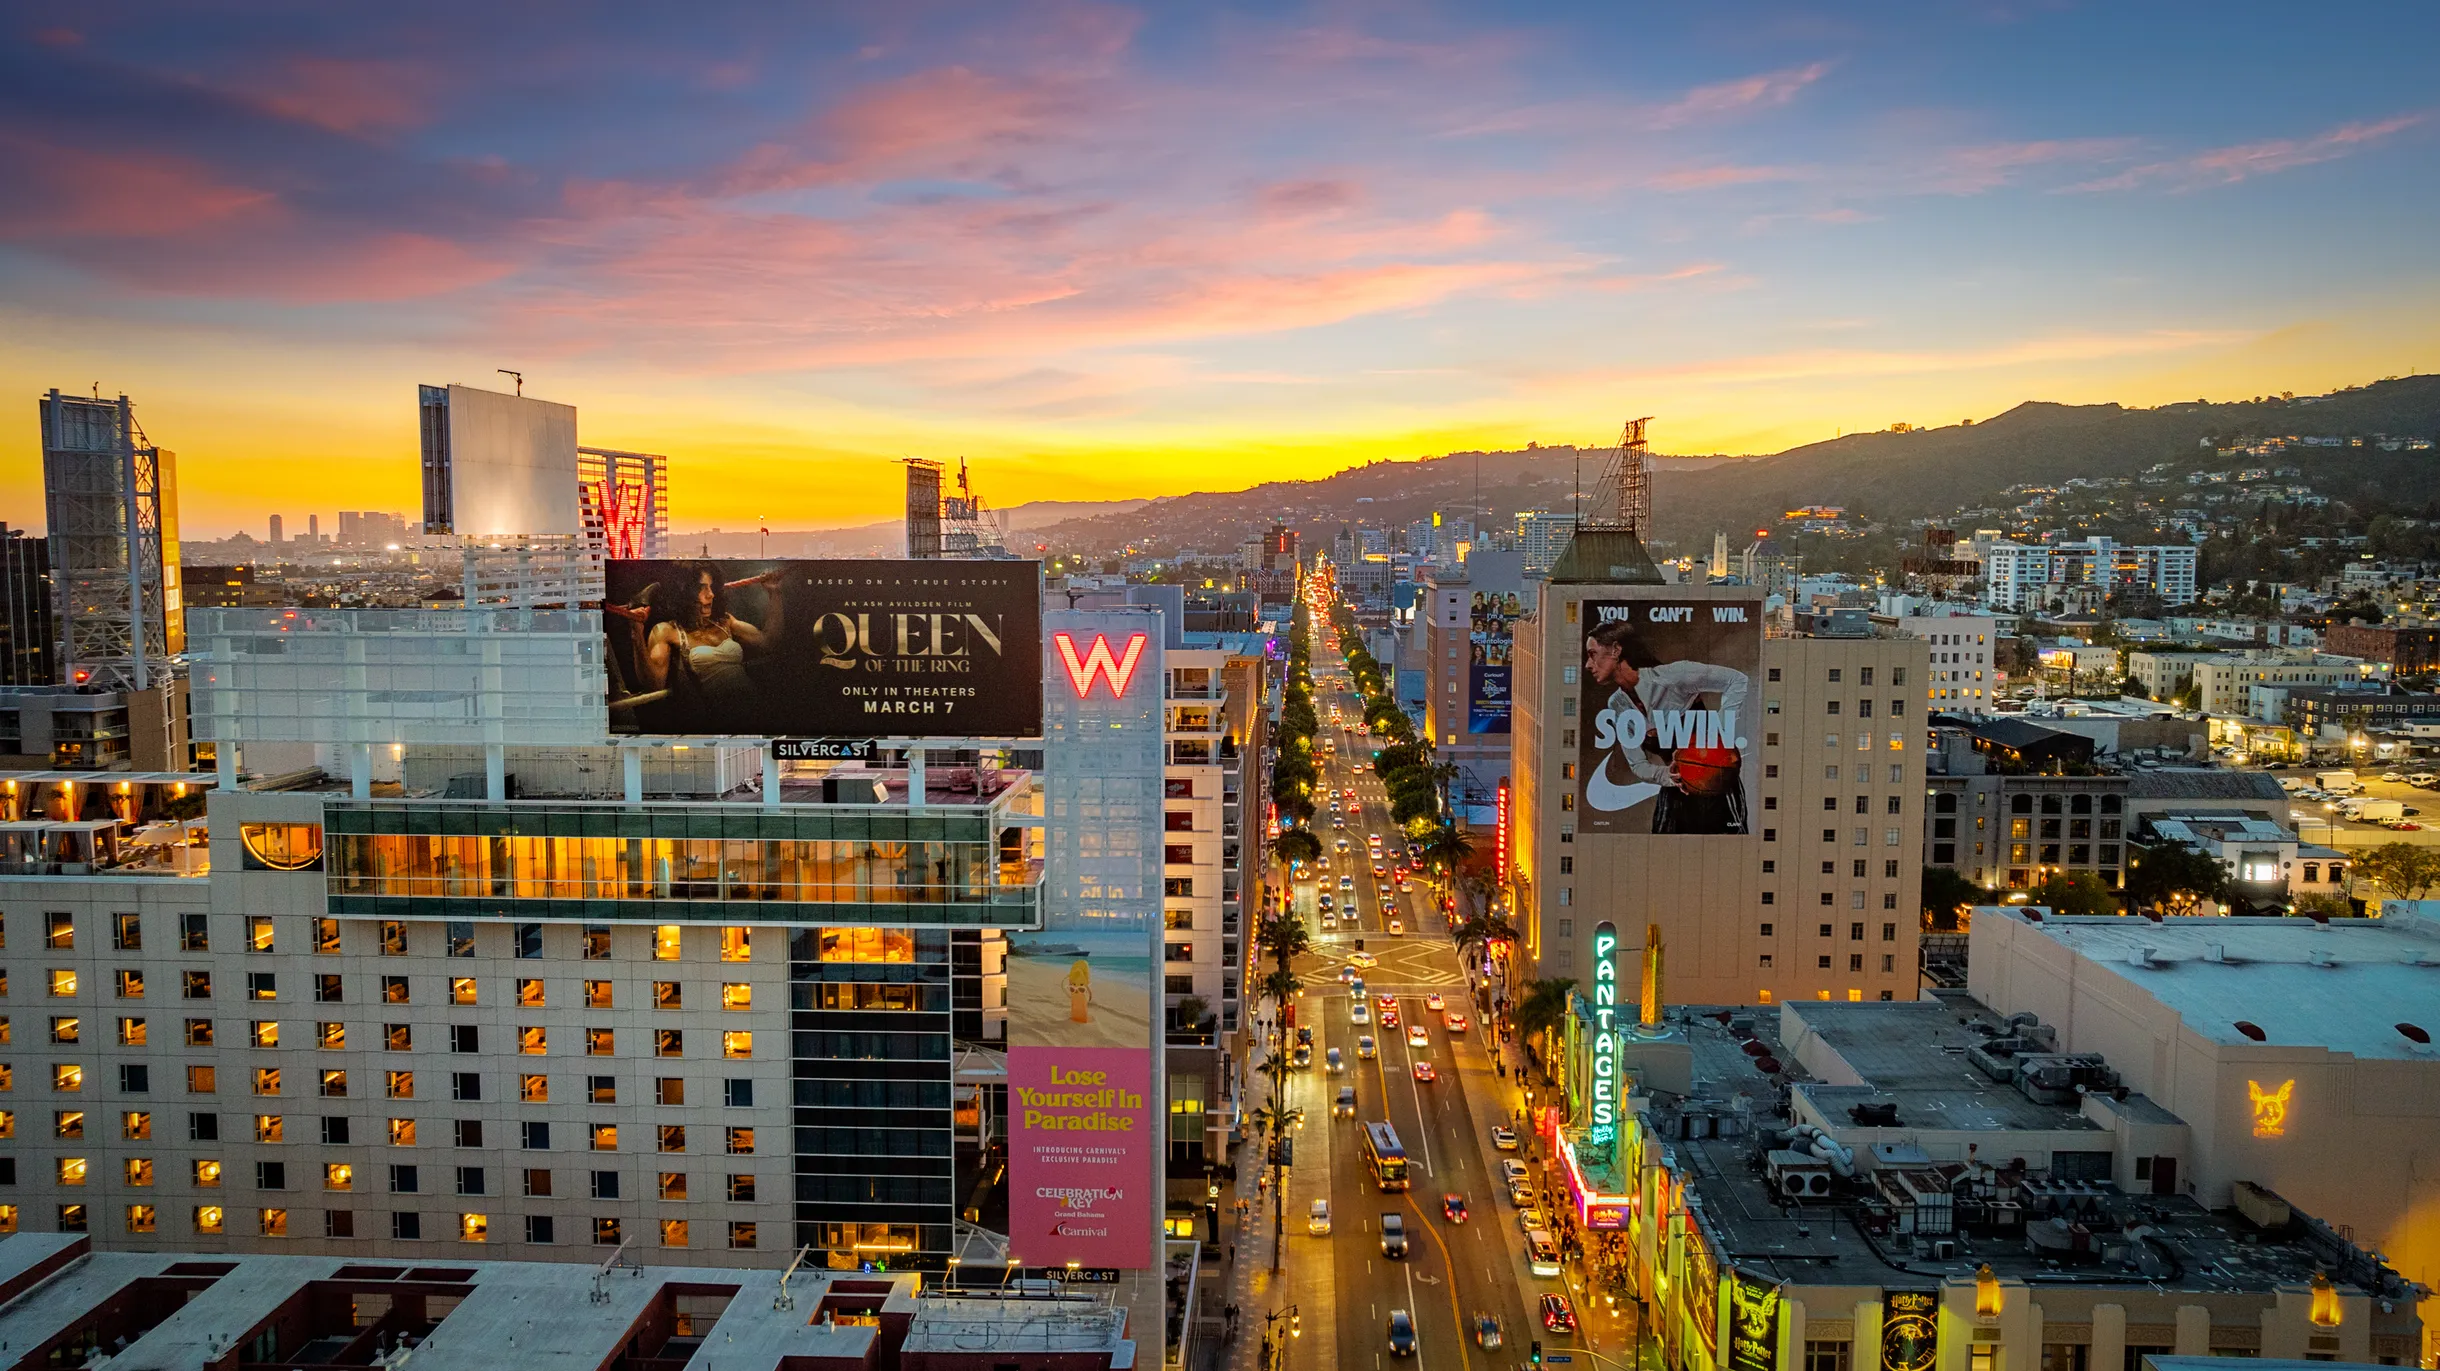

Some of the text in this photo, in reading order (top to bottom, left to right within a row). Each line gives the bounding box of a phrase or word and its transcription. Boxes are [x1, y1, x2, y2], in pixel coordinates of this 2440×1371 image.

[807, 578, 854, 586] BASED
[1597, 606, 1748, 623] YOU CAN'T WIN.
[813, 612, 1003, 670] QUEEN
[864, 659, 971, 673] OF THE RING
[1054, 633, 1147, 699] W
[842, 686, 976, 697] ONLY IN THEATERS
[864, 701, 954, 714] MARCH 7
[1594, 708, 1748, 750] SO WIN.
[1594, 936, 1615, 1125] PANTAGES
[1051, 1065, 1107, 1086] Lose
[1016, 1087, 1143, 1109] Yourself In
[1024, 1109, 1134, 1131] Paradise
[1033, 1146, 1127, 1155] INTRODUCING CARNIVAL'S
[1041, 1155, 1118, 1164] EXCLUSIVE PARADISE
[1036, 1187, 1123, 1200] CELEBRATION
[1067, 1199, 1094, 1210] KEY
[1077, 1211, 1105, 1219] Bahama
[1061, 1225, 1107, 1237] Carnival
[1890, 1294, 1912, 1308] Harry
[1733, 1336, 1753, 1352] Harry
[1752, 1340, 1772, 1360] Potter
